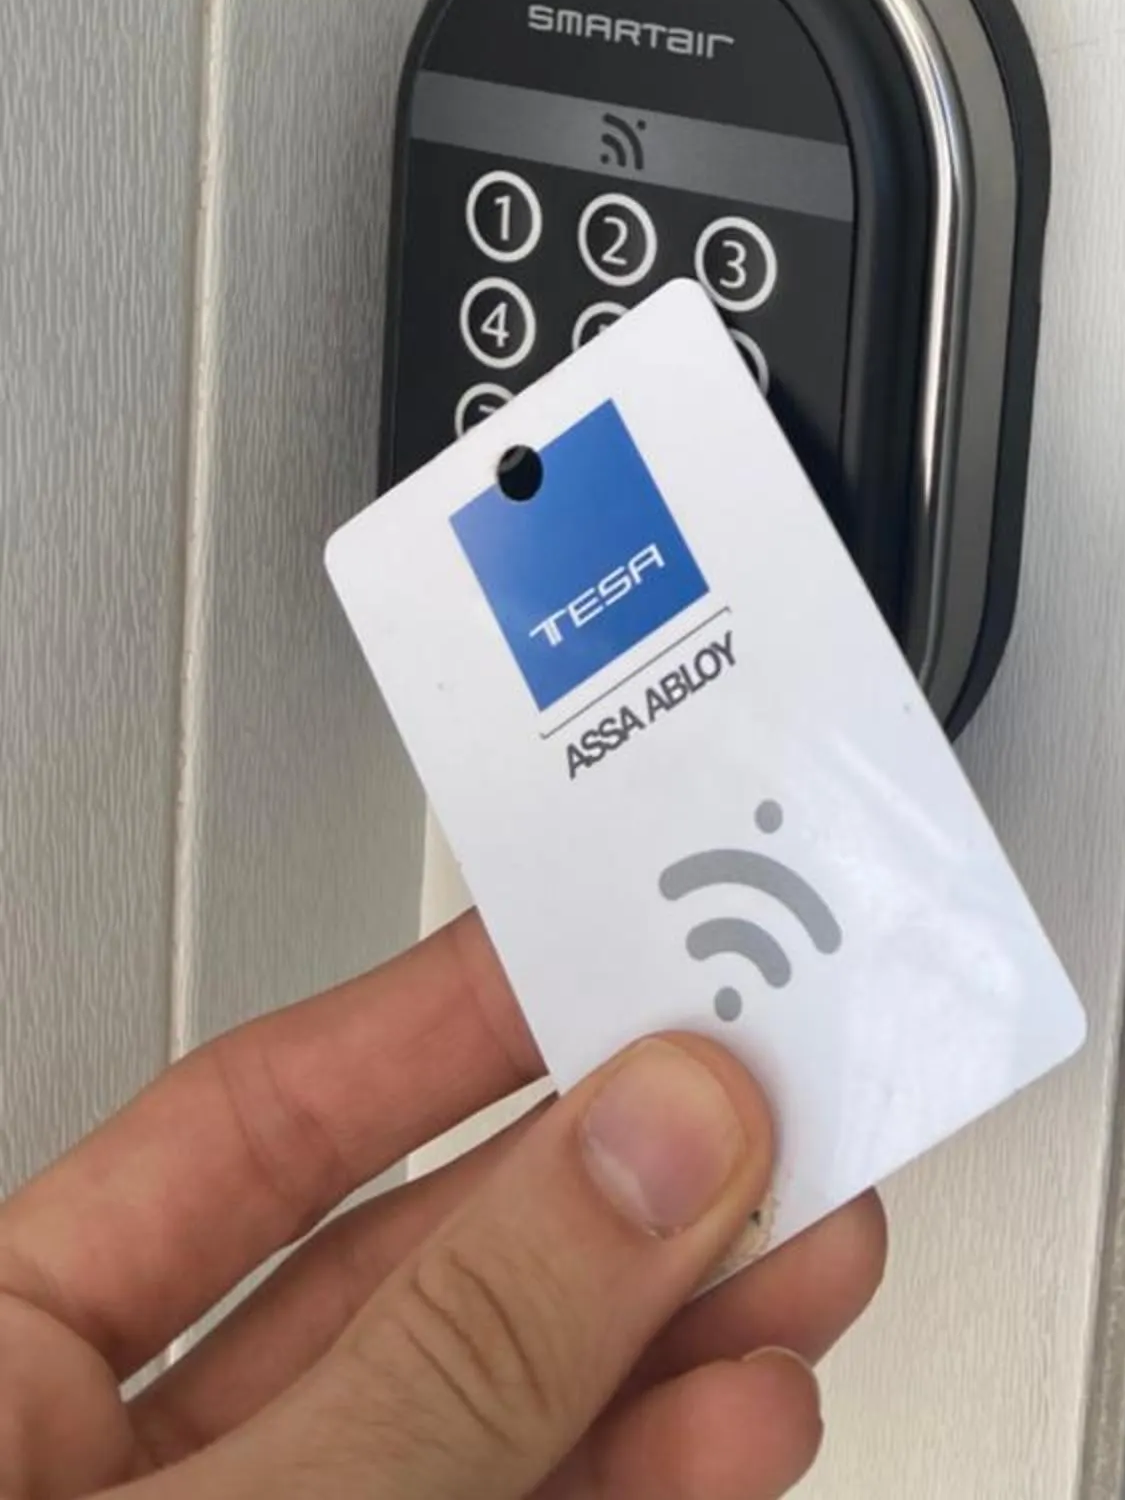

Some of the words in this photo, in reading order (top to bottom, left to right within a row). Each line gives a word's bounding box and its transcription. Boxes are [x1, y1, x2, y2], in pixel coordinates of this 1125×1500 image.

[494, 195, 513, 241] 1
[600, 216, 628, 265] 2
[719, 240, 747, 289] 3
[480, 301, 509, 347] 4
[529, 543, 666, 647] TESA
[565, 706, 645, 780] ASSA
[643, 630, 737, 723] ABLOY
